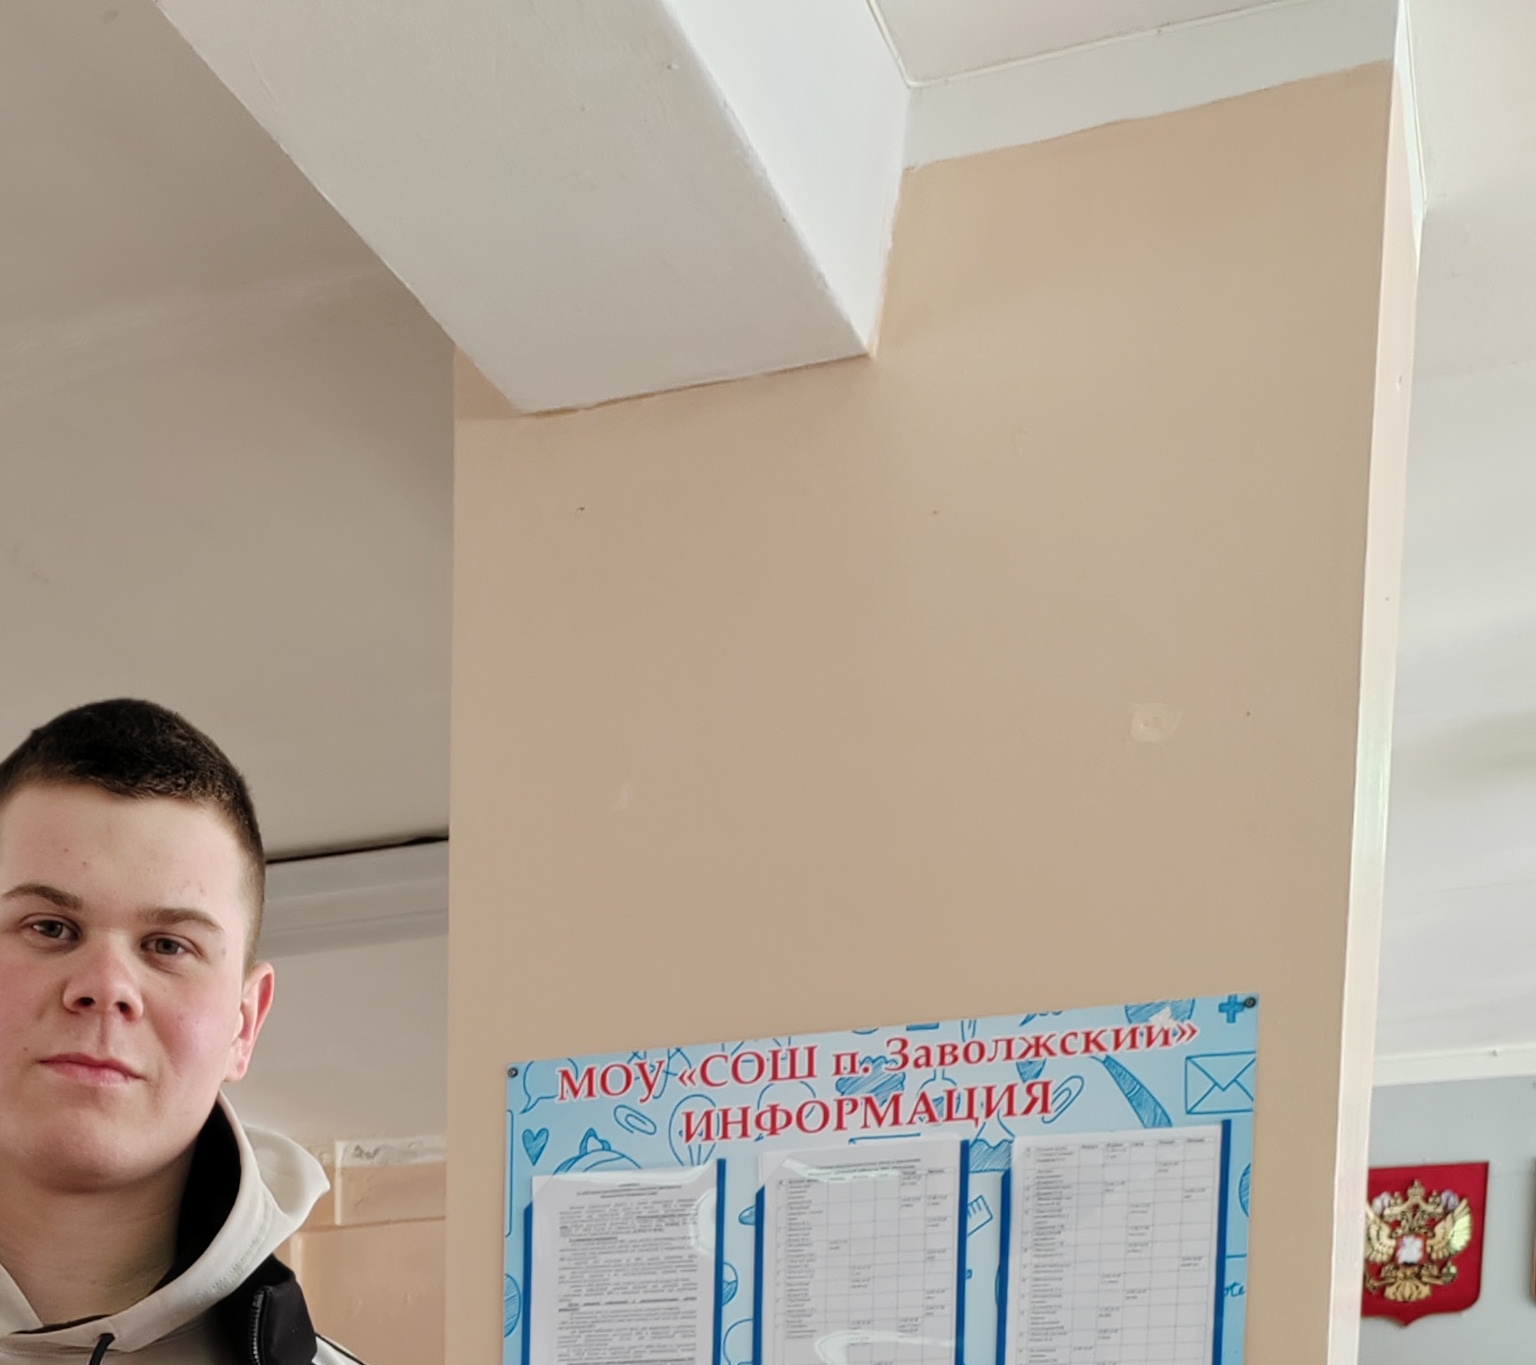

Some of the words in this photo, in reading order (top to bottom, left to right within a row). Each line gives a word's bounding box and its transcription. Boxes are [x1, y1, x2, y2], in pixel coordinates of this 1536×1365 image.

[556, 1060, 665, 1103] МОУ
[678, 1045, 819, 1089] «СОШ
[832, 1052, 870, 1077] п.
[681, 1079, 1054, 1144] ИНФОРМАЦИЯ
